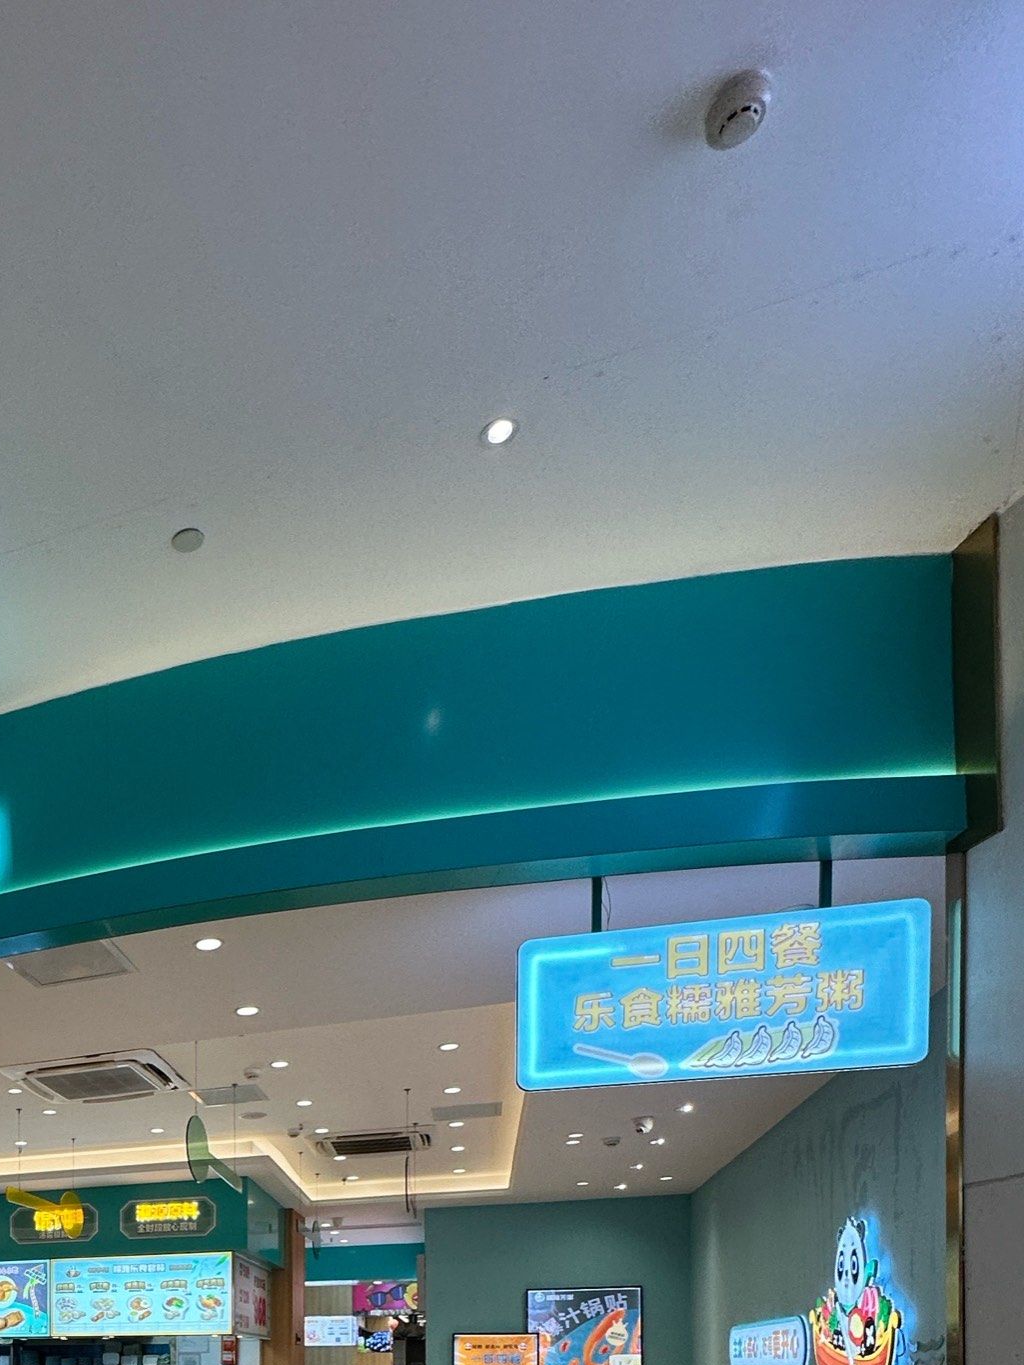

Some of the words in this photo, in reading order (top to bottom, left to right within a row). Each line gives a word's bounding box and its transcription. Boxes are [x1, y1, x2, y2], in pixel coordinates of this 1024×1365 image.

[612, 921, 822, 980] 一日四餐
[572, 969, 866, 1034] 乐食糯雅芳粥
